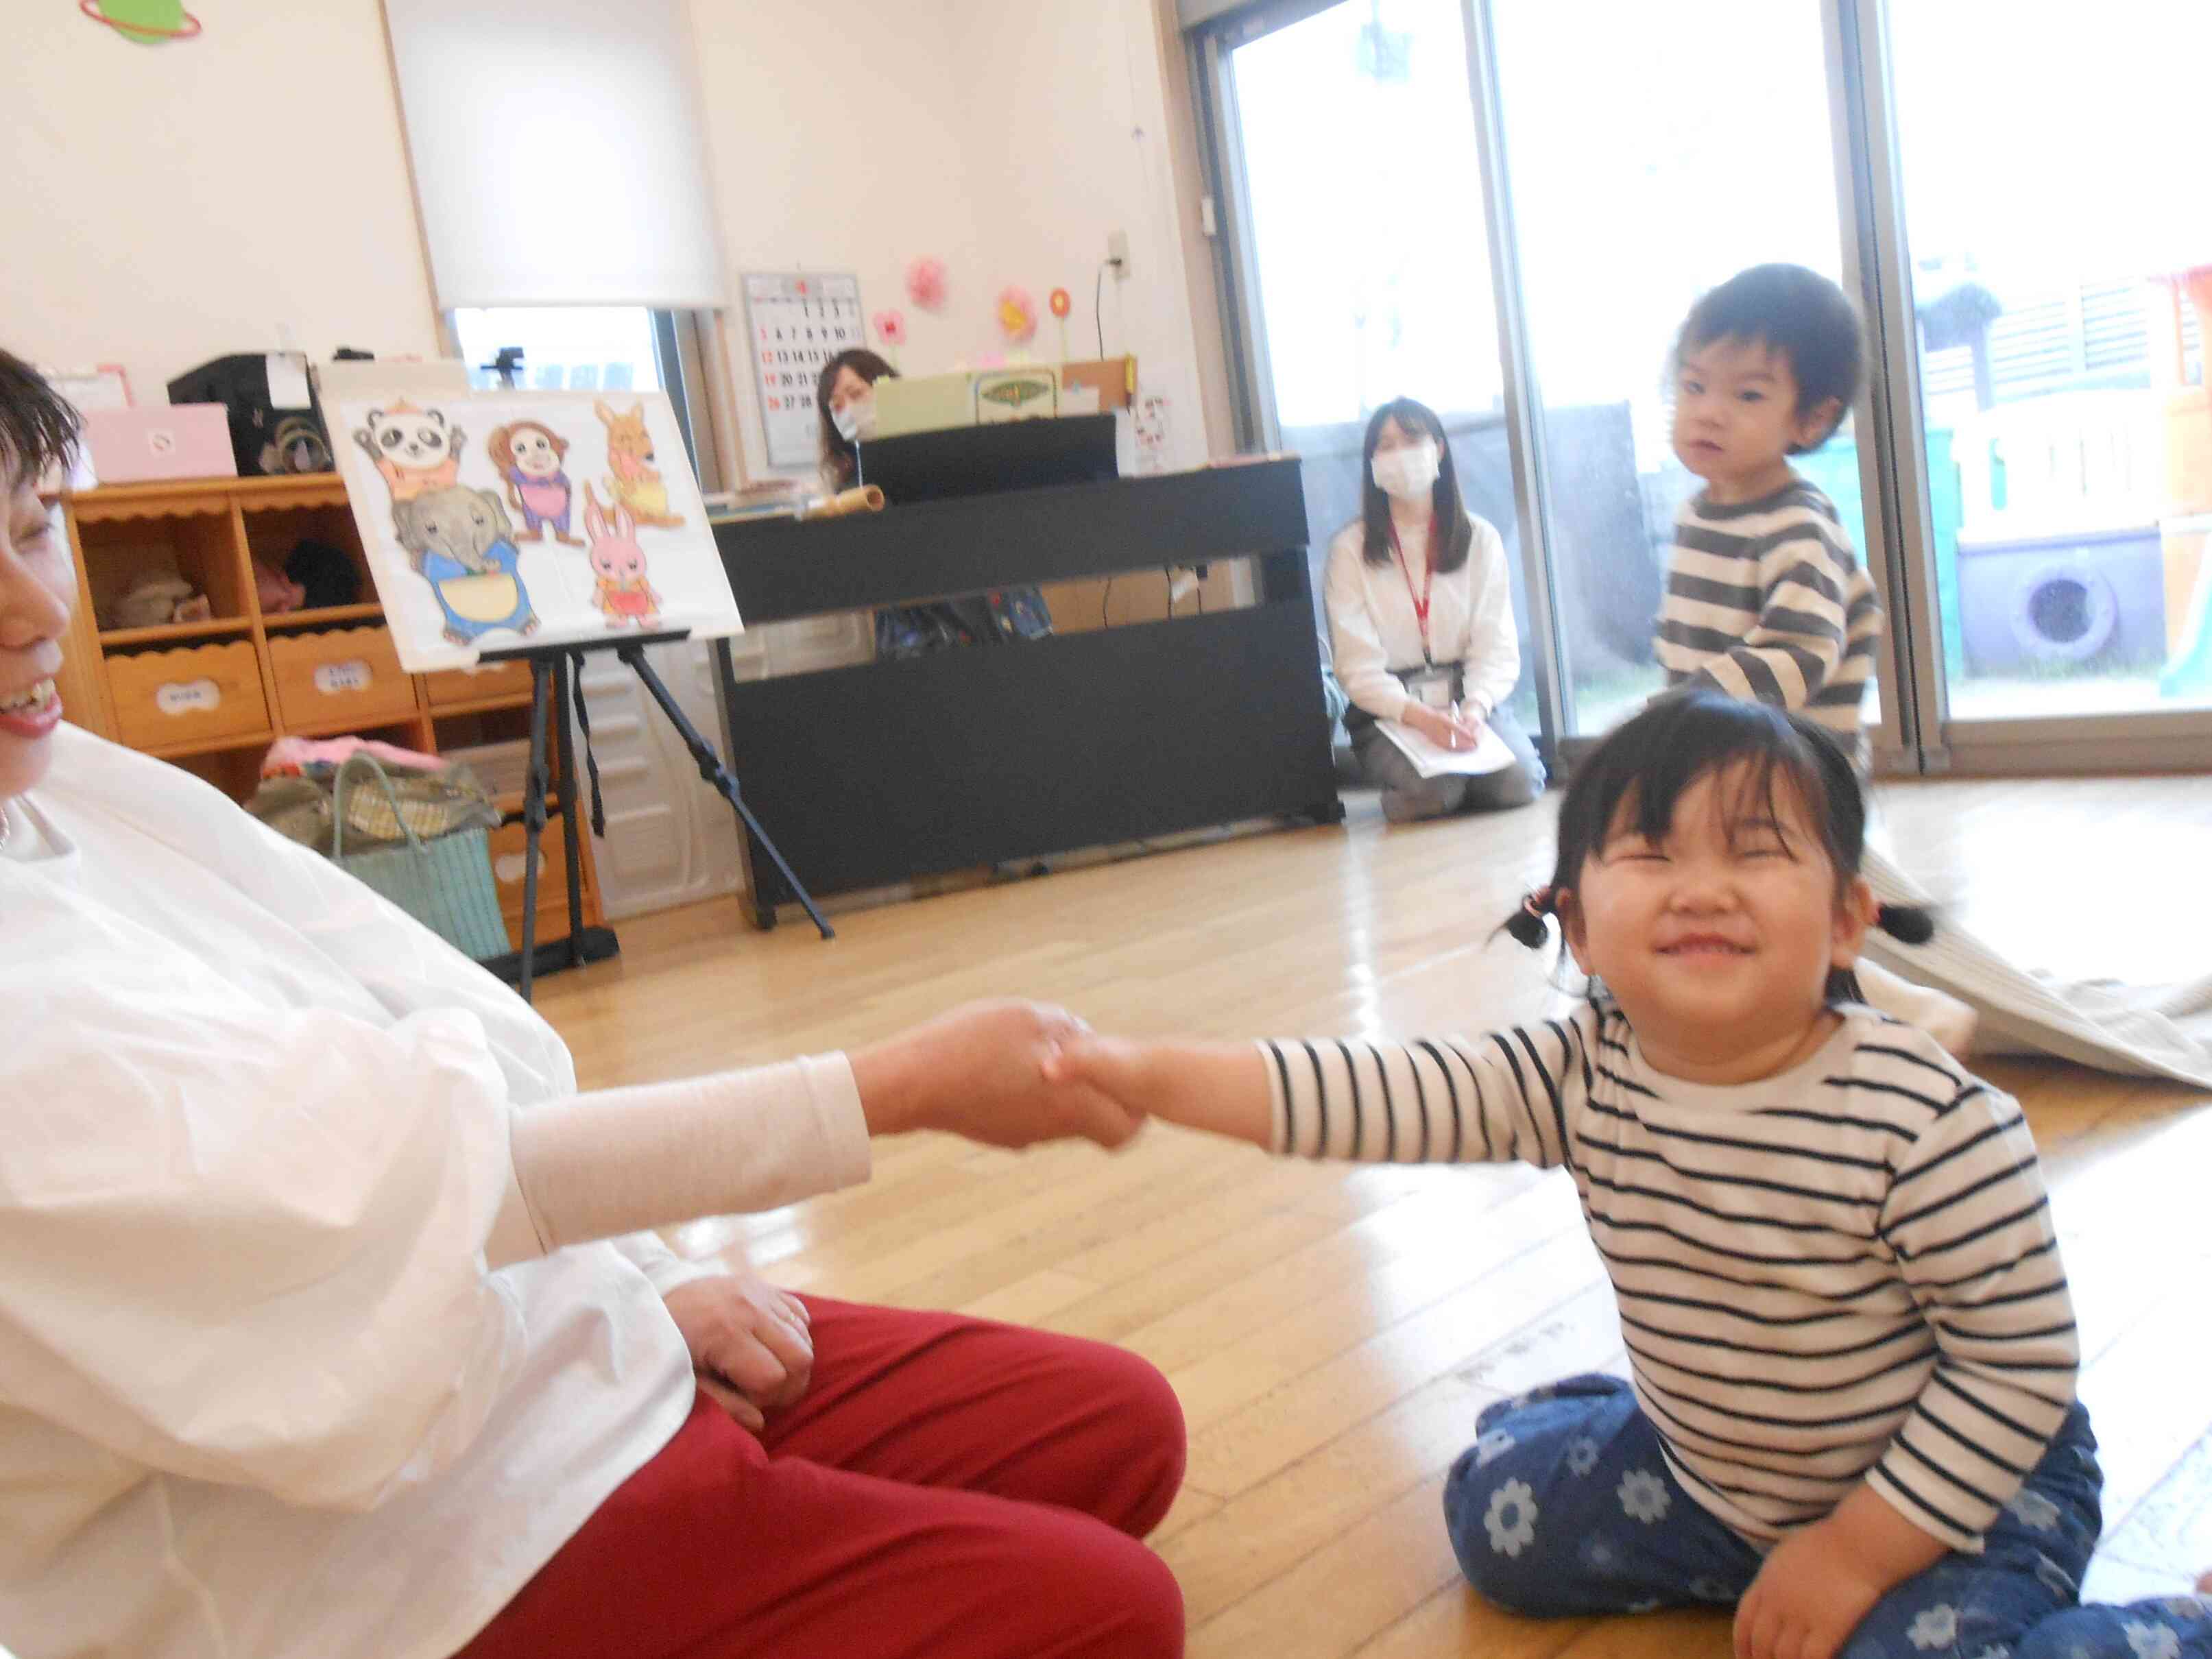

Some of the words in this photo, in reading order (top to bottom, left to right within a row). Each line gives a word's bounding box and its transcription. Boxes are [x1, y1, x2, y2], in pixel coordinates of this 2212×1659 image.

[835, 326, 845, 339] 10
[762, 351, 773, 363] 12
[778, 350, 789, 363] 13
[793, 350, 804, 363] 14
[808, 350, 819, 363] 15
[765, 373, 777, 386] 19
[782, 374, 793, 386] 20
[797, 373, 808, 385] 21
[768, 396, 780, 410] 26
[784, 396, 794, 408] 27
[800, 396, 812, 409] 28
